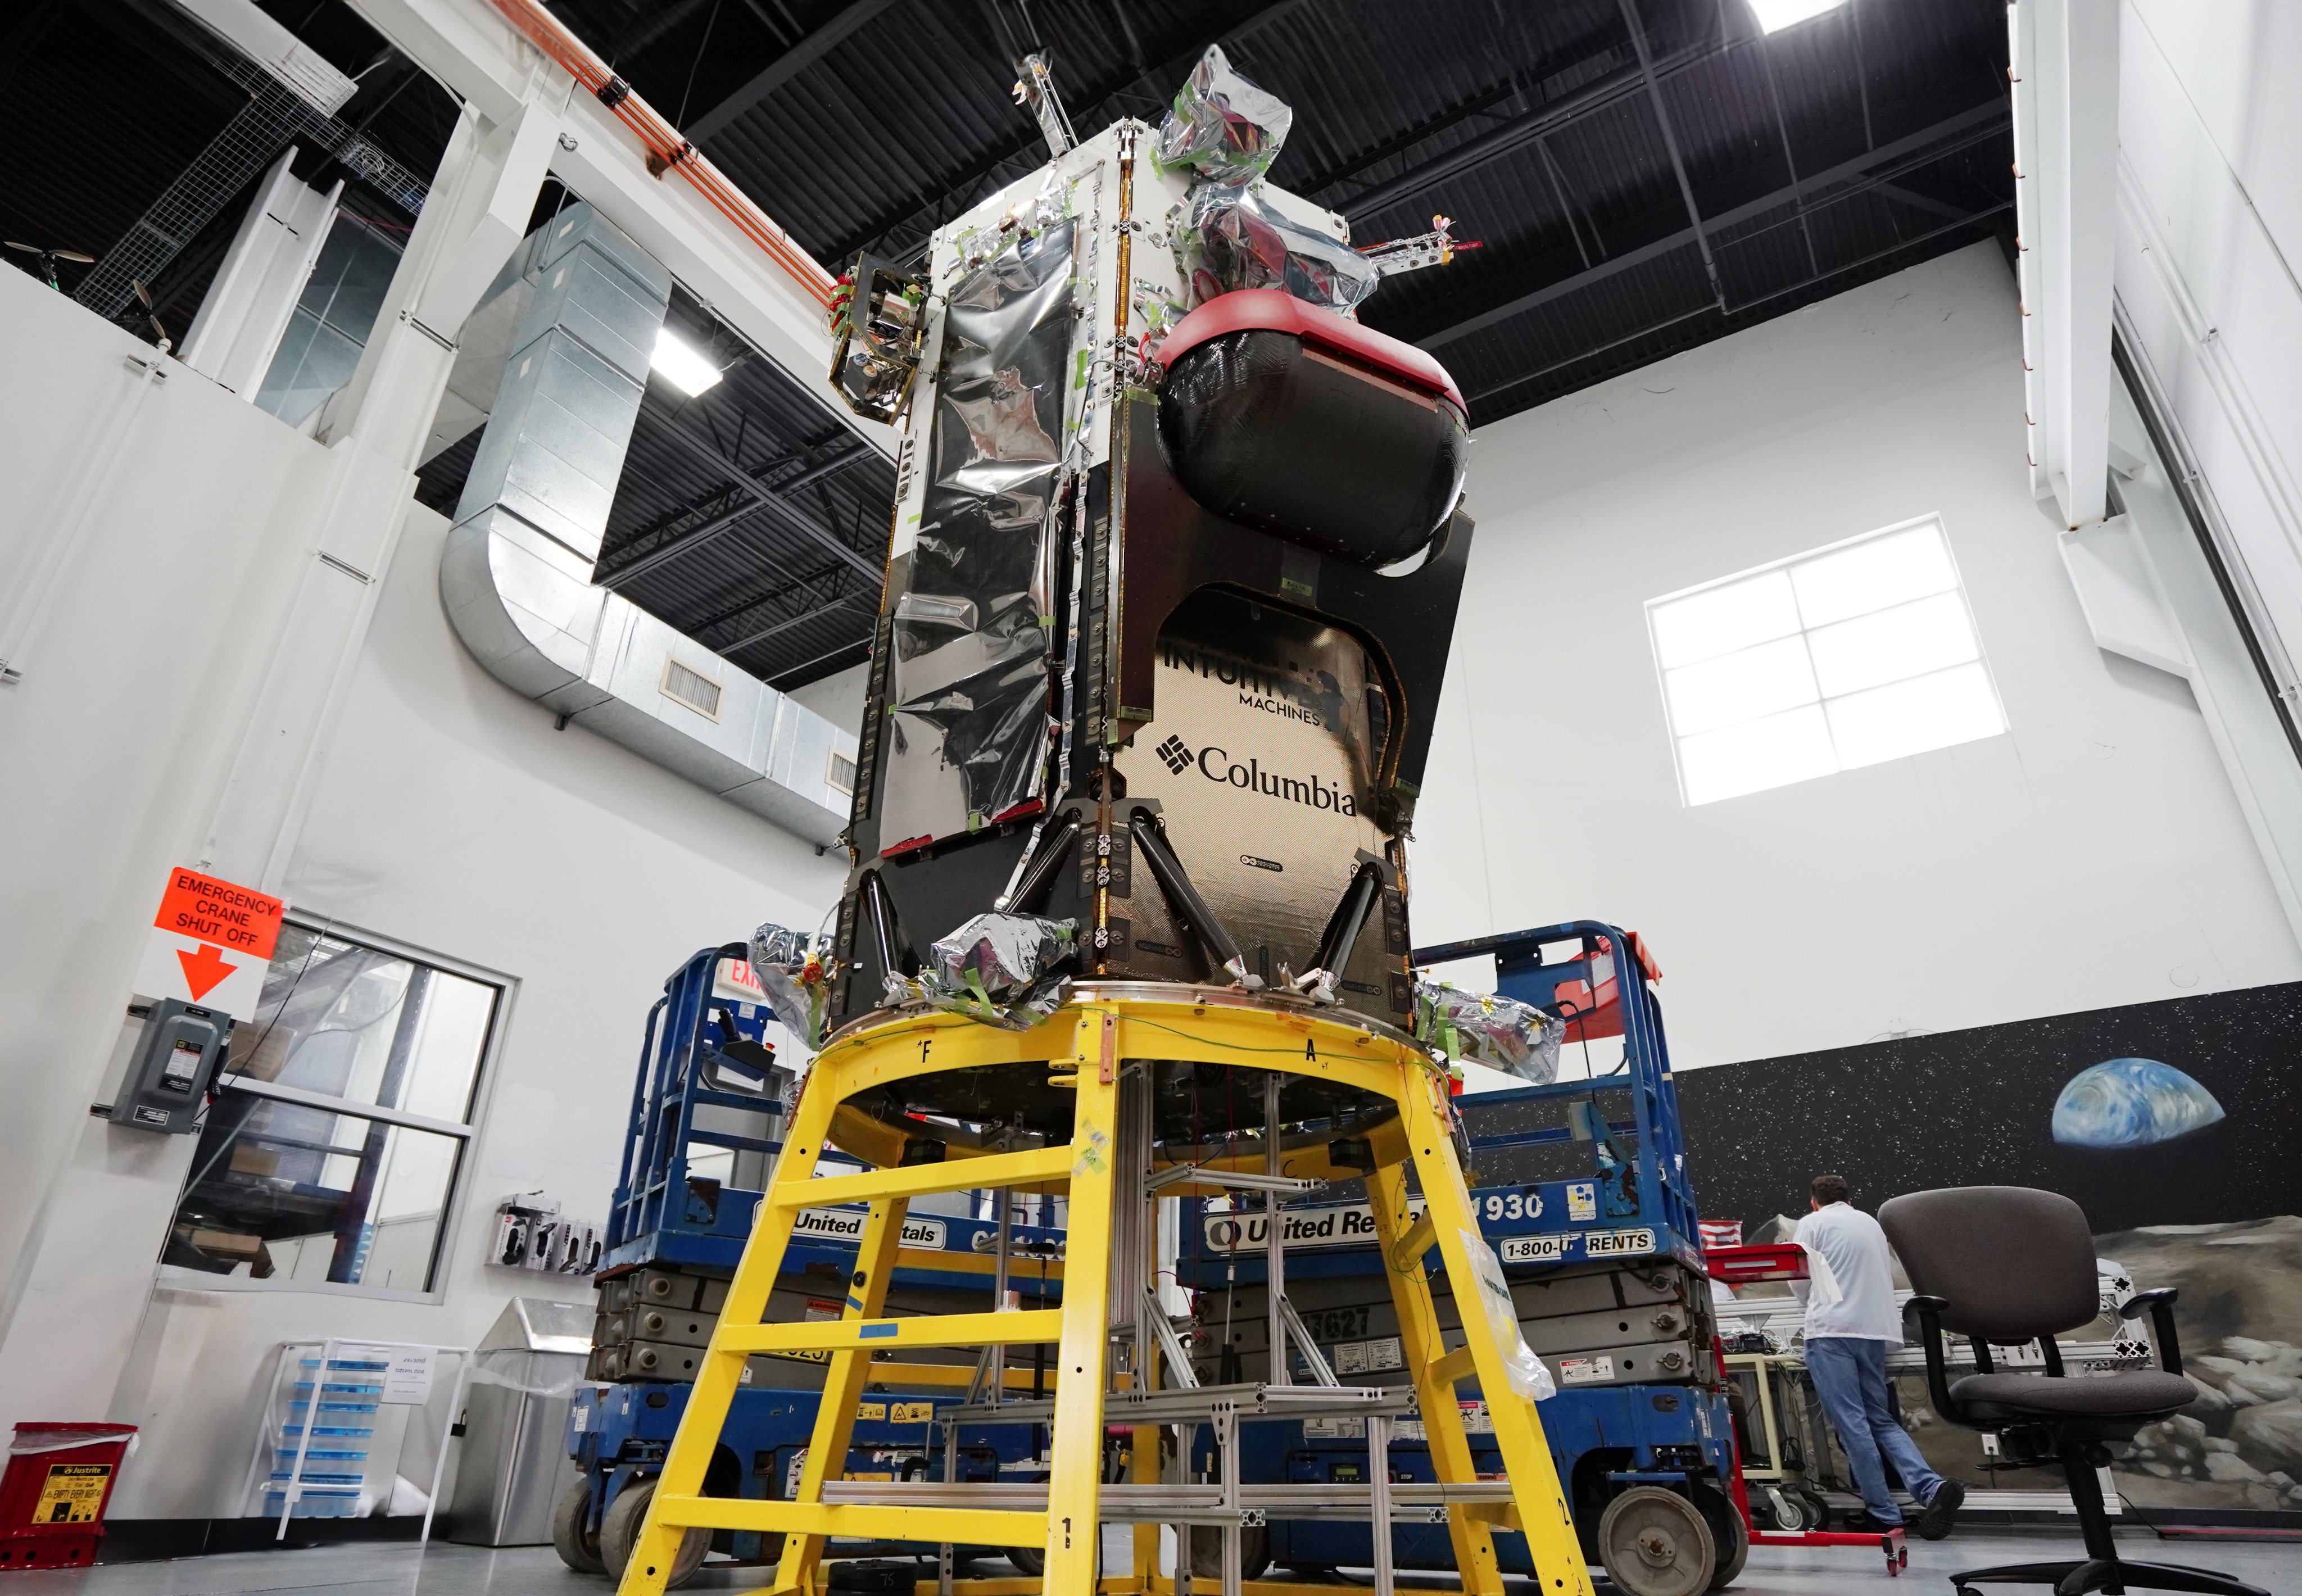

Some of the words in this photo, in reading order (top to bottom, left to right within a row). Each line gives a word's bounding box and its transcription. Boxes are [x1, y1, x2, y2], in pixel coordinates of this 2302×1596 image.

[1239, 692, 1320, 726] MACHINES
[1198, 747, 1357, 817] Columbia
[177, 876, 277, 916] EMERGENCY
[196, 900, 251, 927] CRANE
[176, 913, 222, 936] SHUT
[227, 928, 259, 946] OFF
[732, 959, 760, 990] EXI
[922, 1040, 932, 1063] F
[1306, 1039, 1316, 1062] A
[795, 1213, 862, 1234] United
[901, 1225, 935, 1242] tals
[1248, 1214, 1338, 1242] Uited
[53, 1489, 71, 1499] EMPTY
